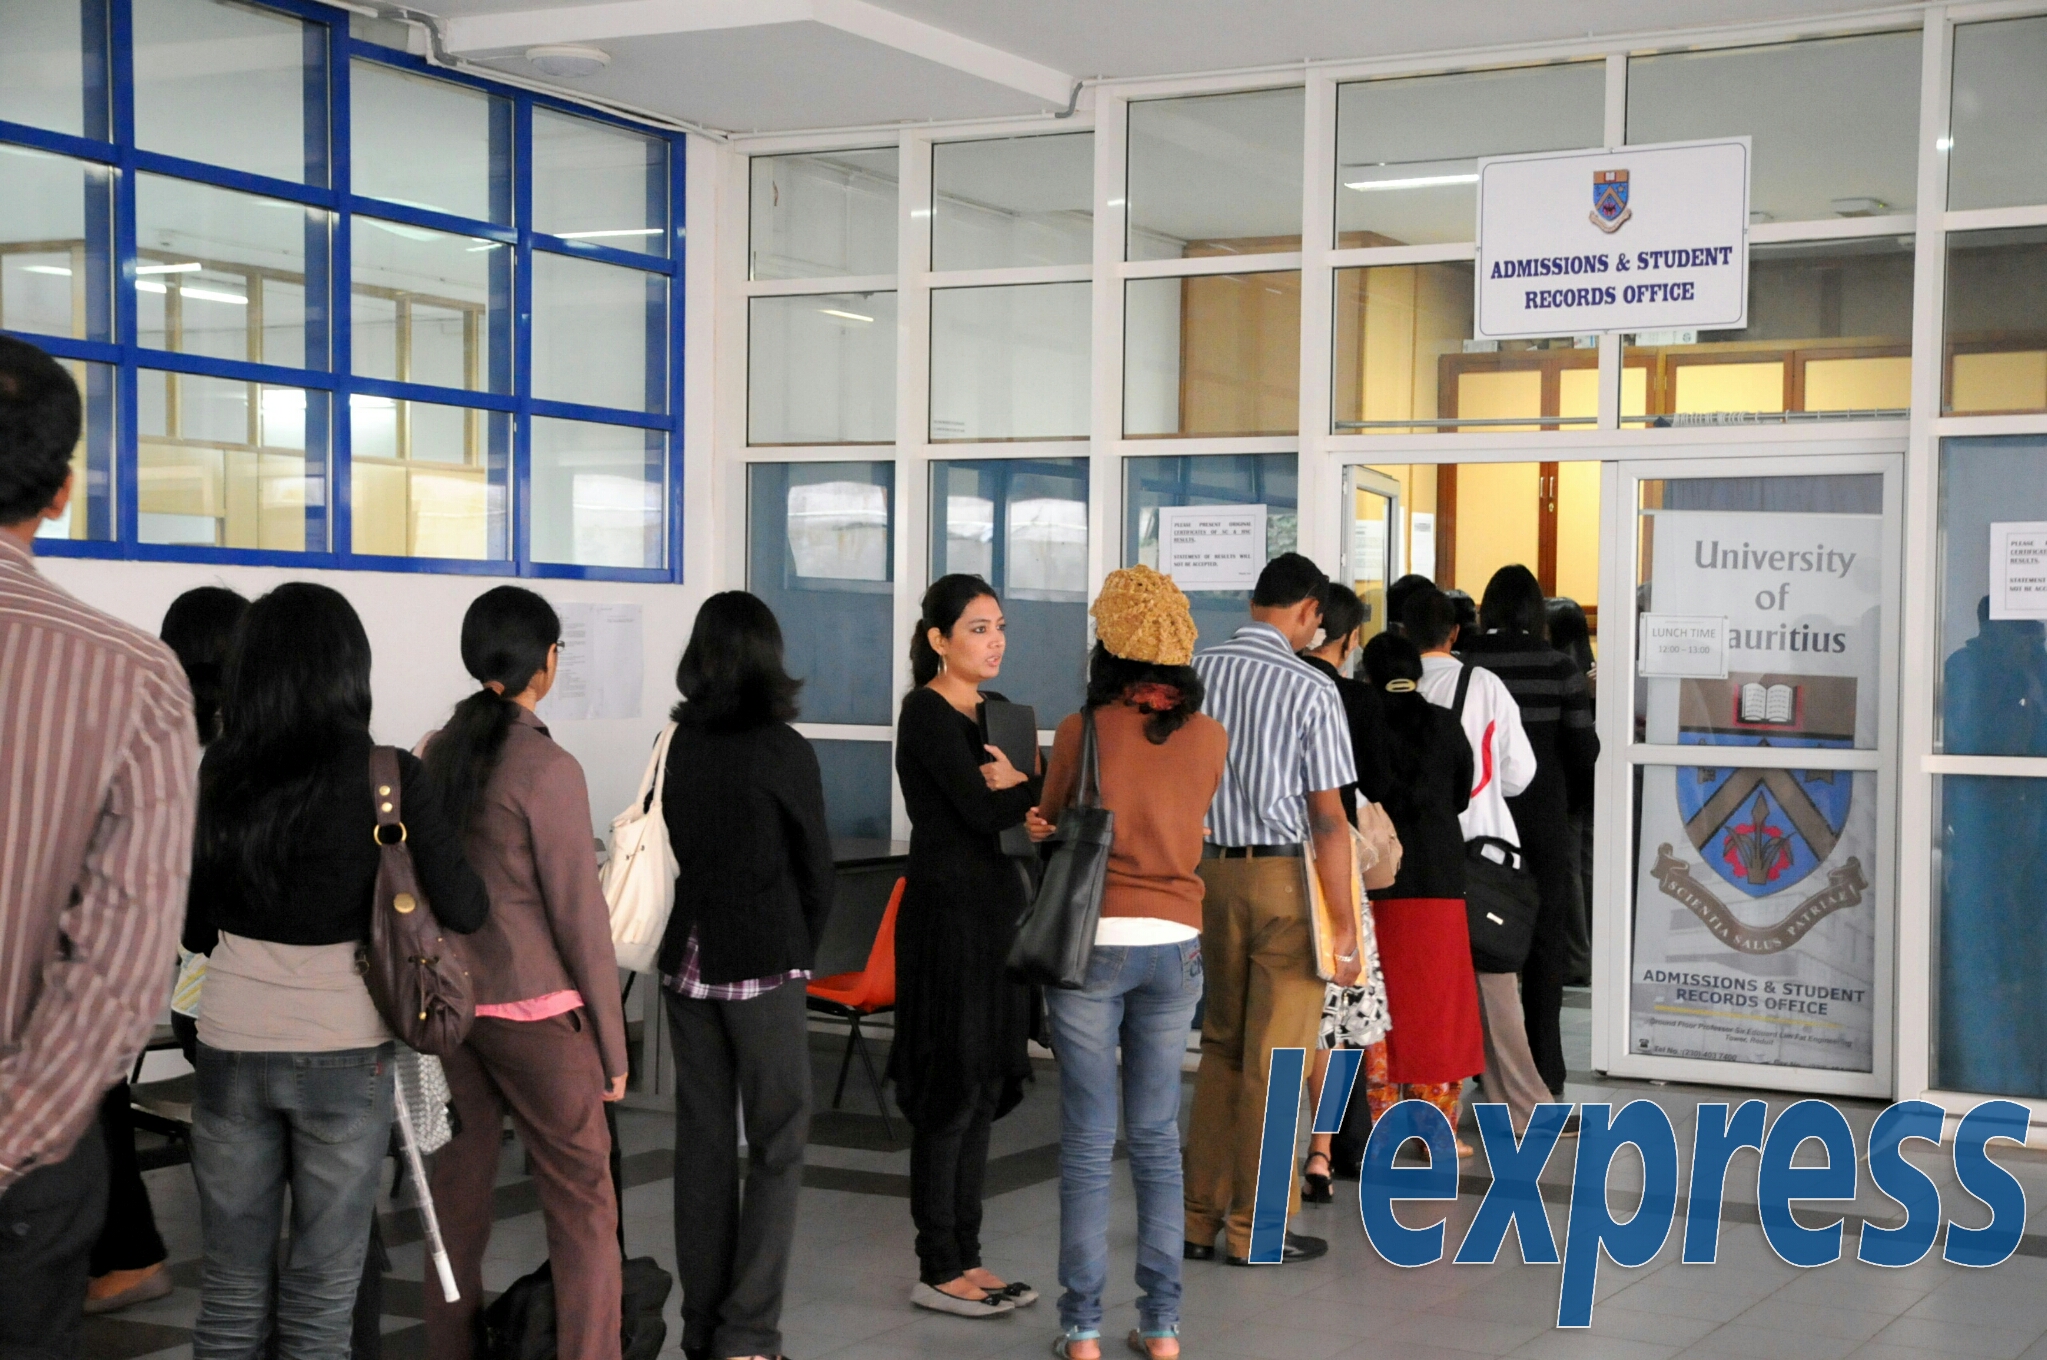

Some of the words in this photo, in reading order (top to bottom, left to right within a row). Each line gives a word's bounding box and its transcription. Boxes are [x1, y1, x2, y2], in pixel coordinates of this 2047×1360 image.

[1491, 254, 1609, 279] ADMISSIONS
[1616, 253, 1631, 272] &
[1637, 246, 1733, 271] STUDENT
[1525, 286, 1617, 309] RECORDS
[1623, 282, 1695, 304] OFFICE
[1695, 540, 1857, 578] University
[1755, 582, 1790, 611] of
[1652, 627, 1687, 638] LUNCH
[1690, 628, 1716, 639] TIME
[1729, 622, 1846, 654] auritius
[1658, 645, 1680, 653] 12:00
[1689, 646, 1710, 654] 13:00
[1667, 881, 1729, 938] SCIENTIA
[1733, 934, 1782, 950] SALUS
[1643, 969, 1758, 992] ADMISSIONS
[1764, 981, 1777, 994] &
[1782, 982, 1865, 1003] STUDENT
[1676, 988, 1759, 1008] RECORDS
[1765, 996, 1828, 1016] OFFICE
